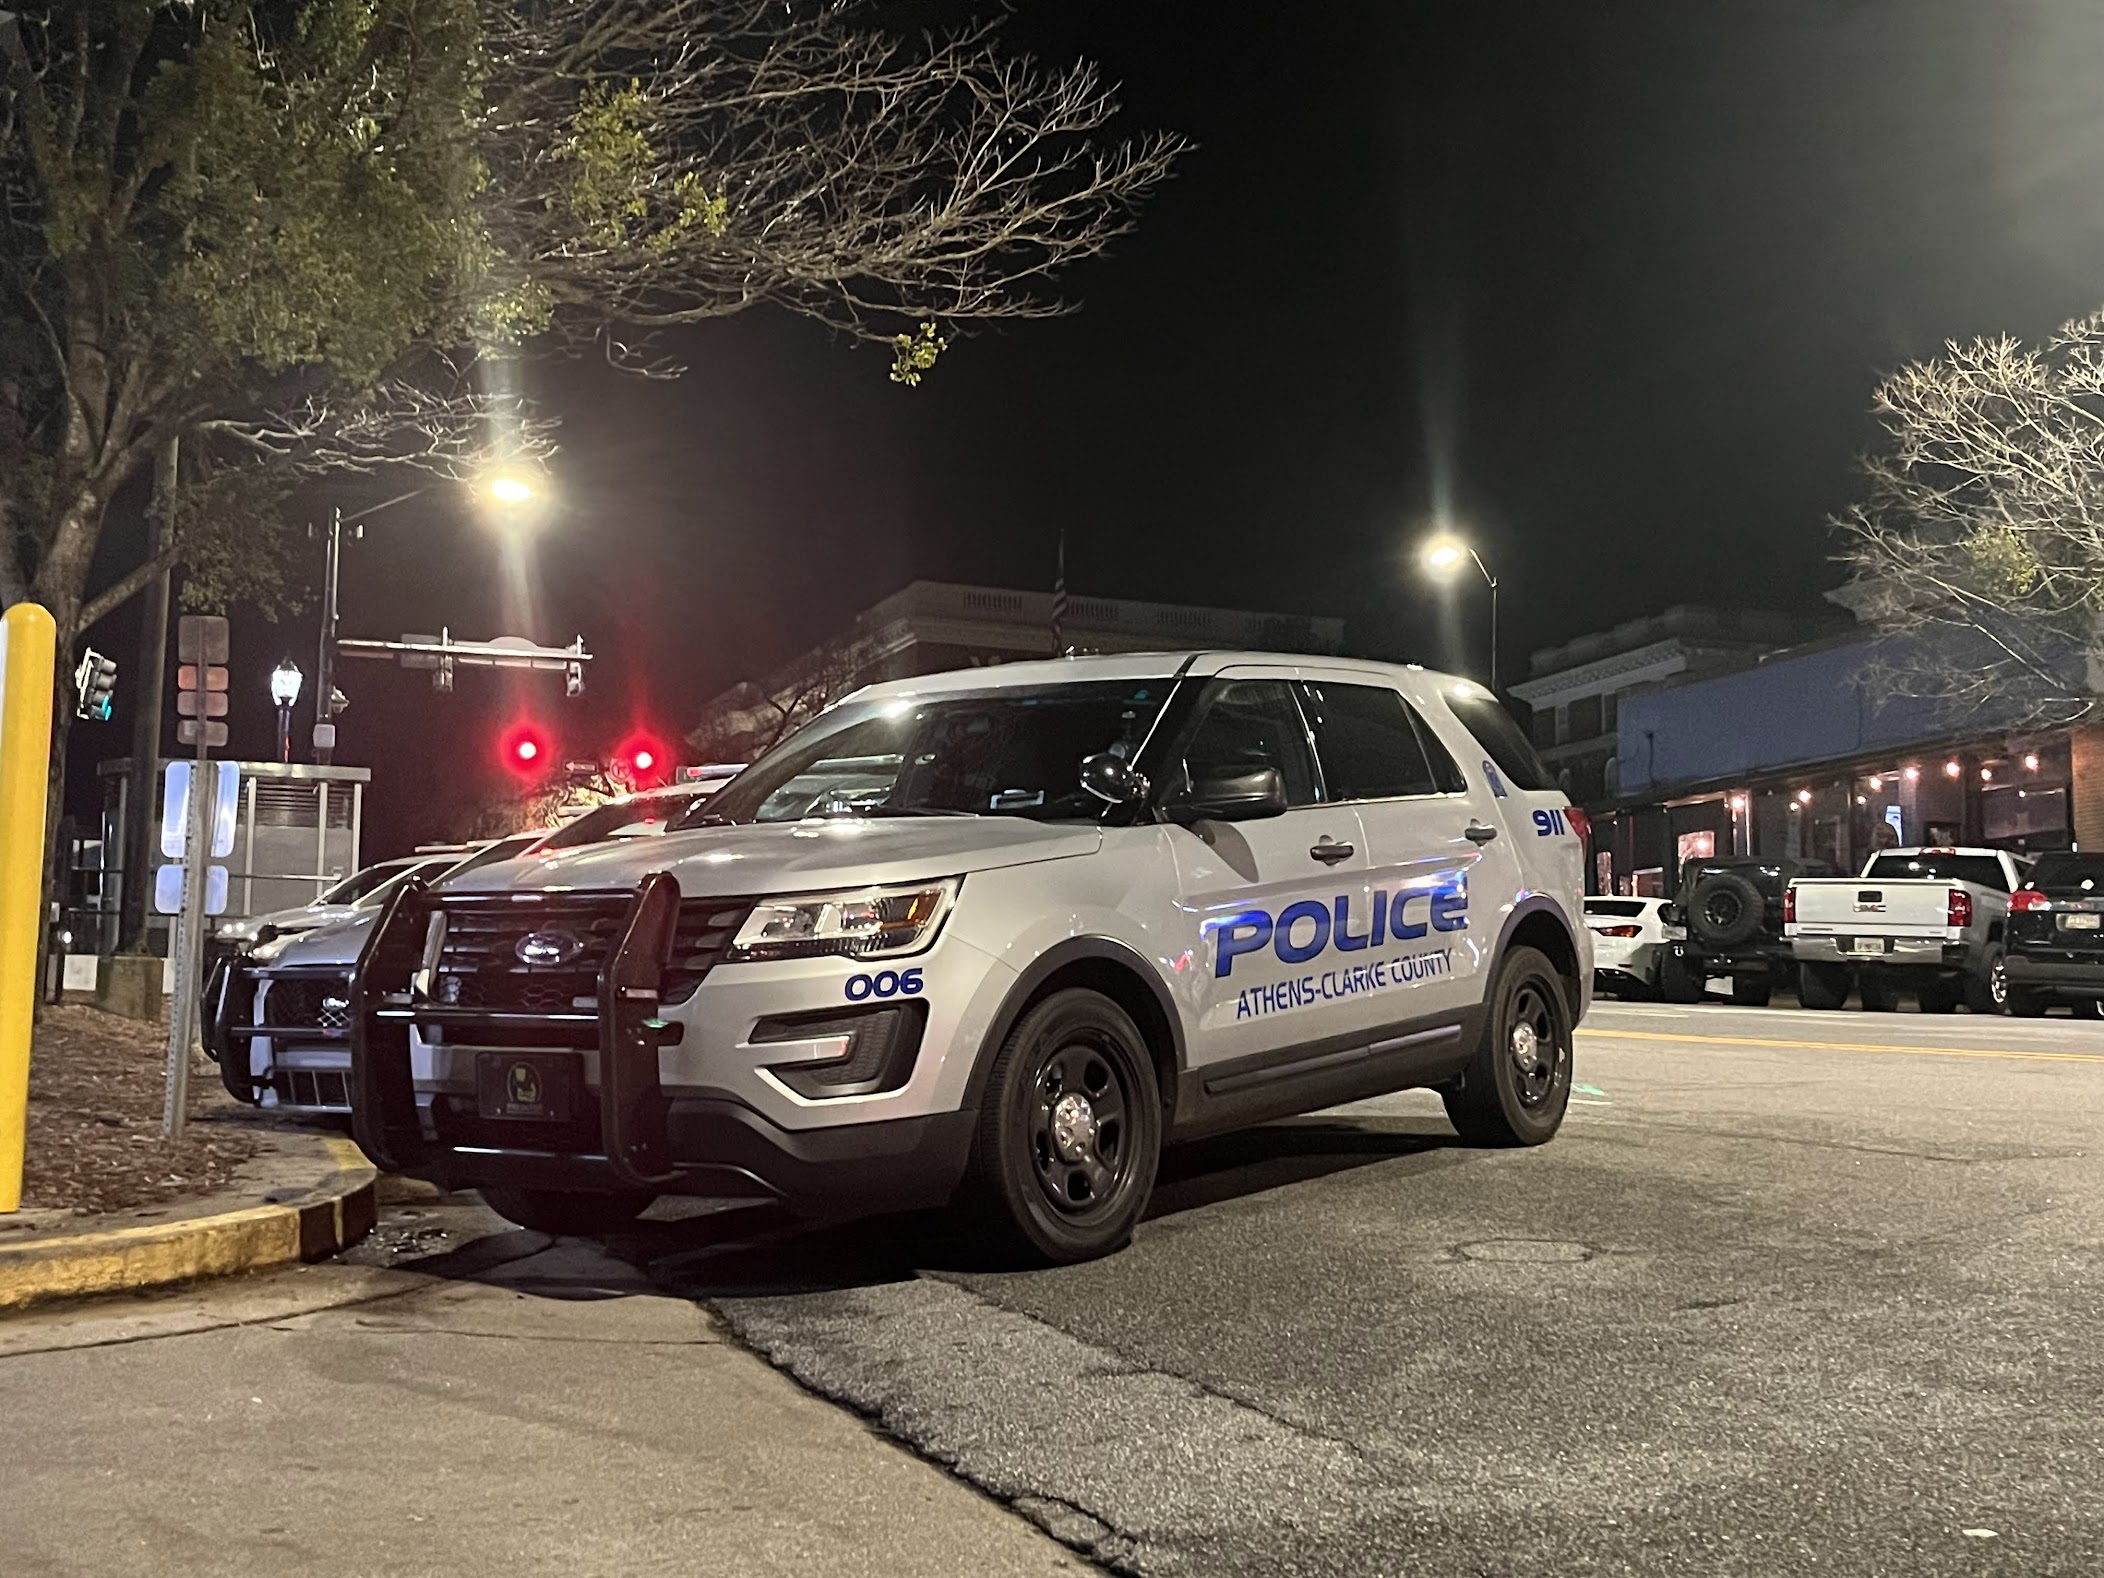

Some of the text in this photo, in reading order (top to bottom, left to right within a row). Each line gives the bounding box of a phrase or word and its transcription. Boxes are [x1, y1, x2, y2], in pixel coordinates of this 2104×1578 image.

[1532, 809, 1565, 837] 911
[1209, 872, 1469, 978] POLICE
[844, 967, 924, 1001] 006
[1236, 947, 1453, 1020] ATHENS-CLARKE COUNTY
